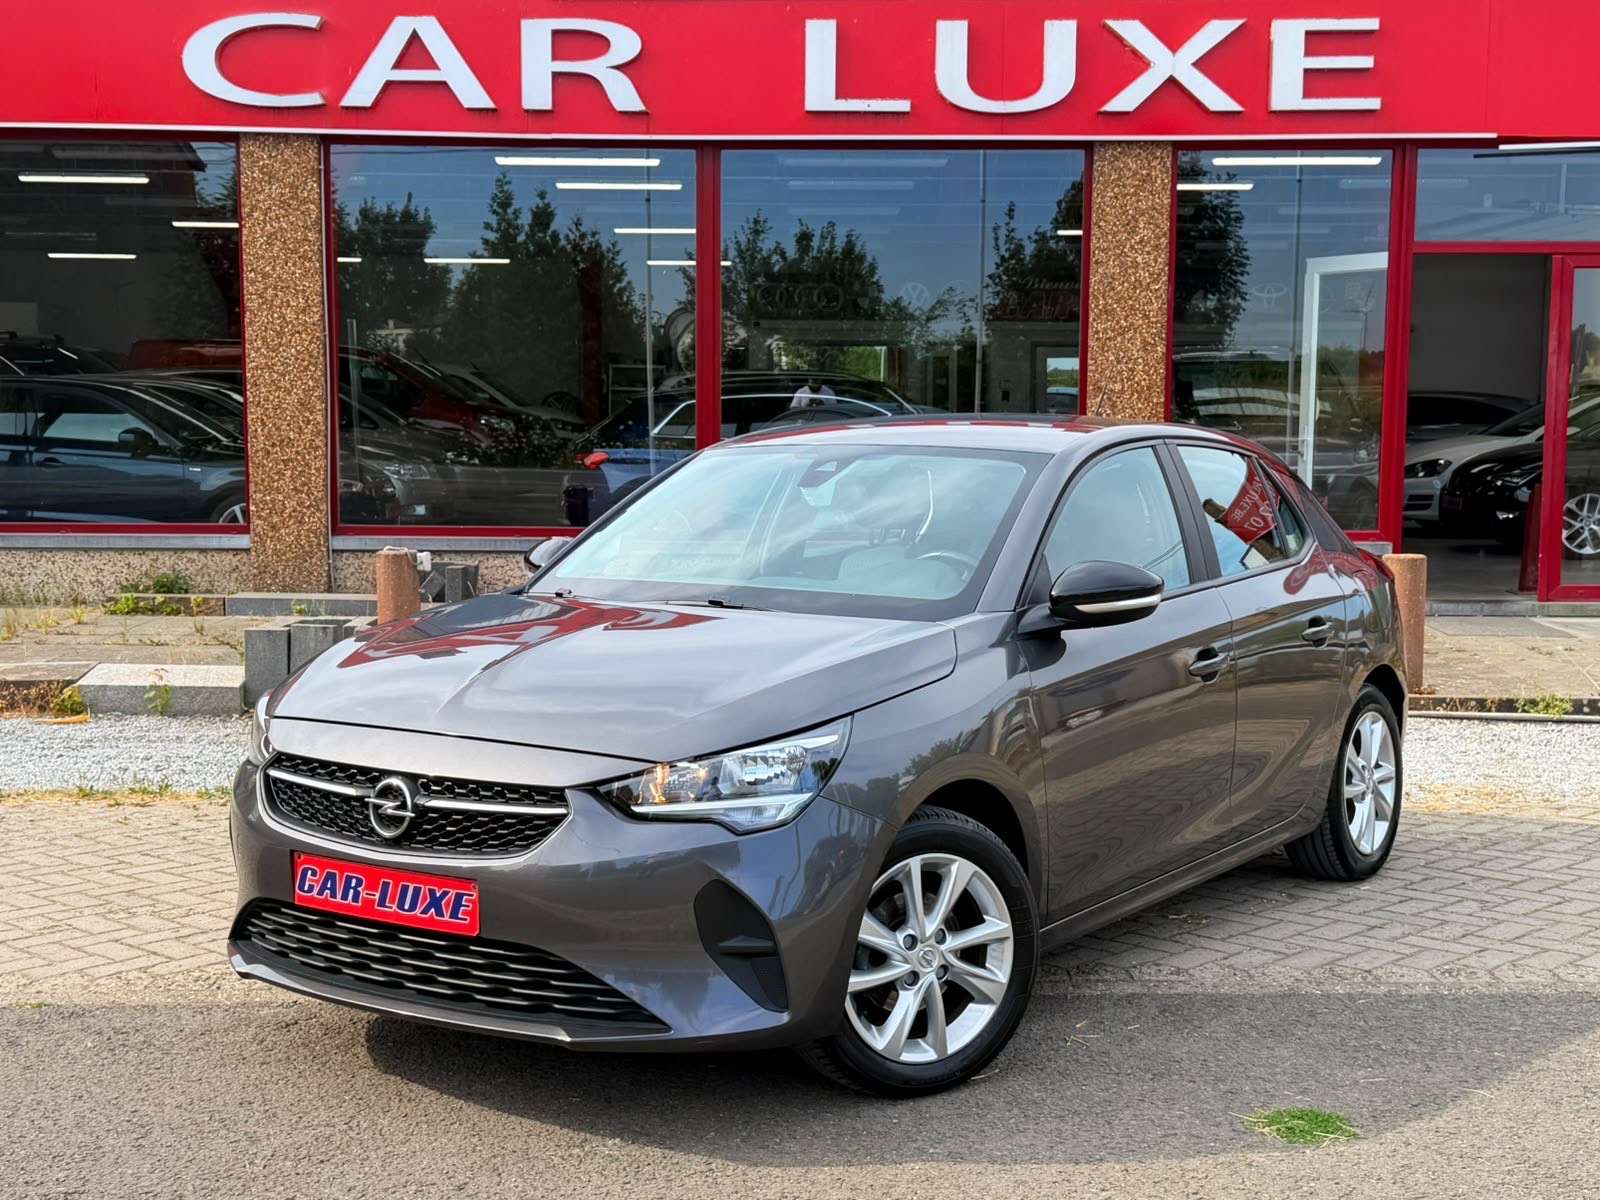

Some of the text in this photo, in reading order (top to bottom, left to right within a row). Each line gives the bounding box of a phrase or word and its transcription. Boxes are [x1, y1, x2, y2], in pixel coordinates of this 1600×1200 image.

[182, 13, 1382, 113] CAR LUXE
[296, 865, 476, 924] CAR-LUXE
